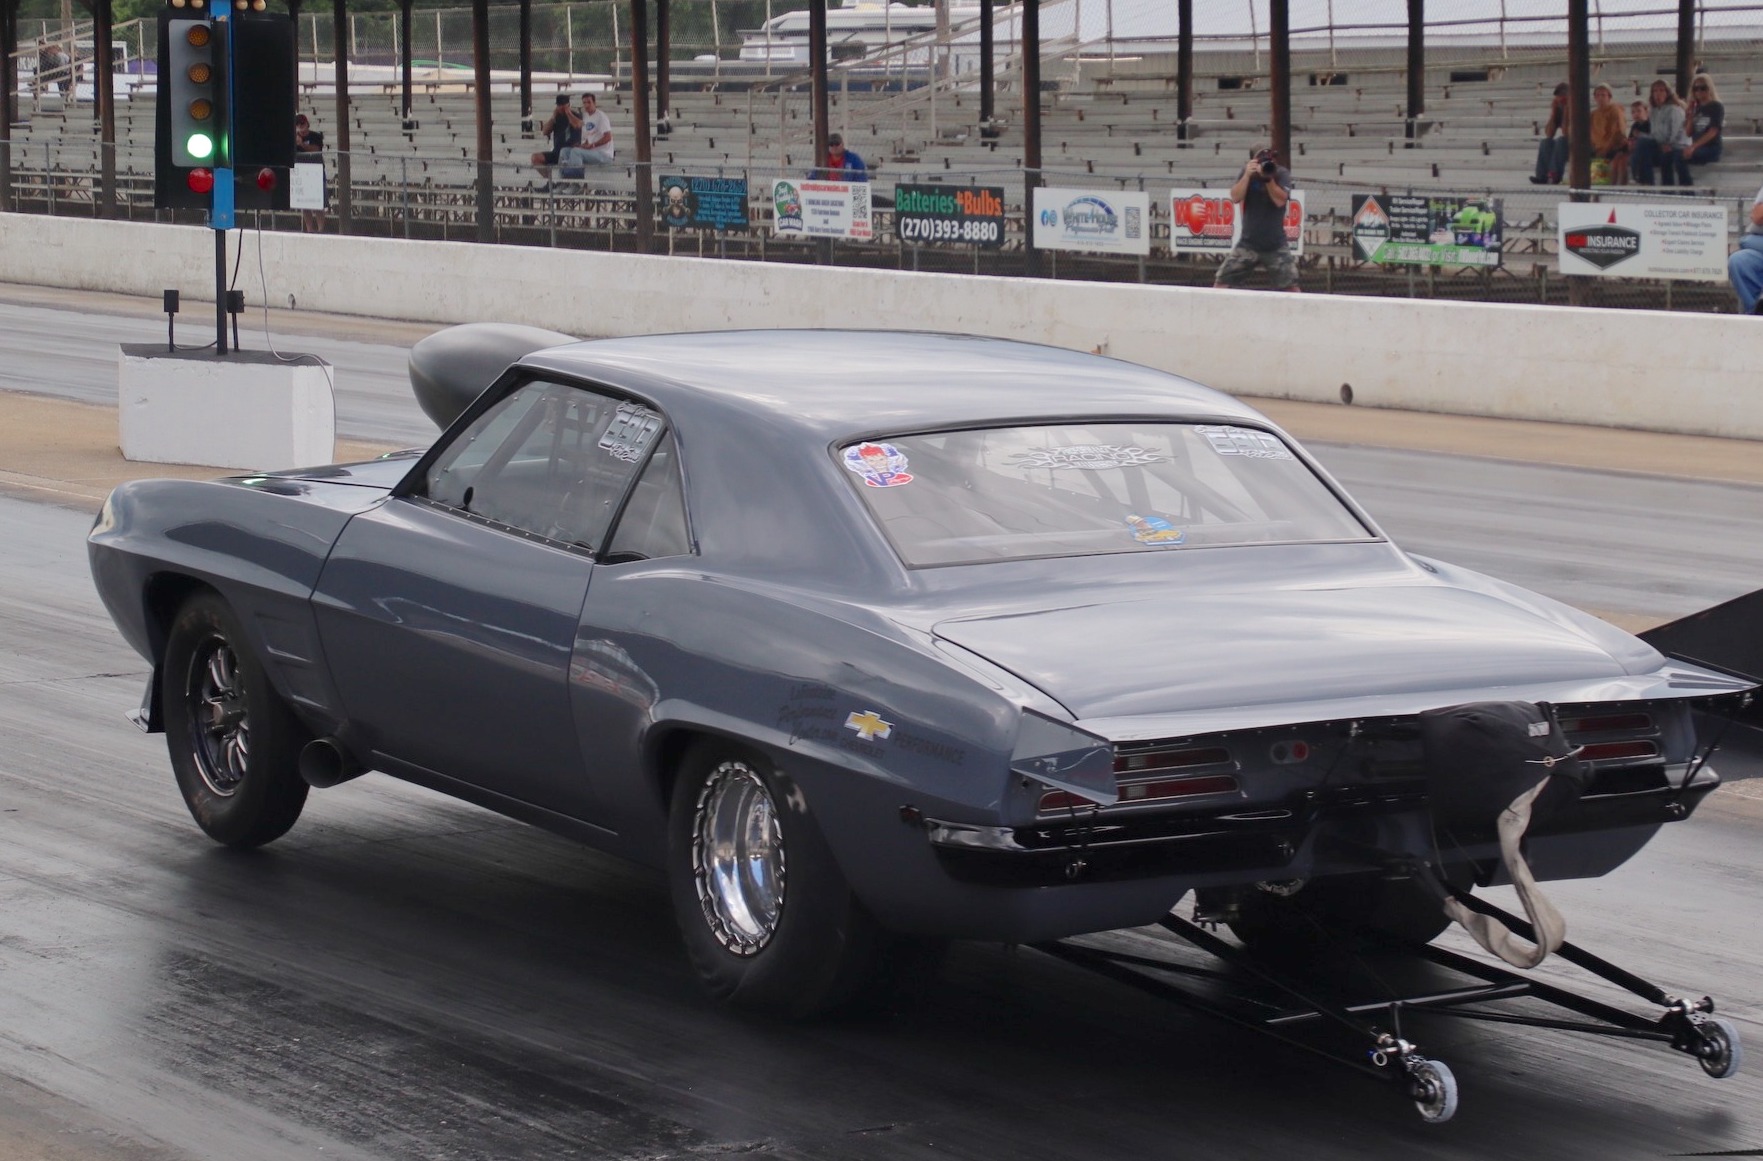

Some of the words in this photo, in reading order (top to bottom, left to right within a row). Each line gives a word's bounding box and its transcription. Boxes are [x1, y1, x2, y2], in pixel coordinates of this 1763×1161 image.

[1173, 194, 1235, 234] WORLD
[1644, 209, 1677, 218] COLLECTOR
[1678, 210, 1690, 218] CAR
[1691, 211, 1724, 220] INSURANCE
[900, 216, 998, 240] (270)393-8880
[1588, 236, 1637, 248] INSURANCE
[866, 472, 896, 486] VP
